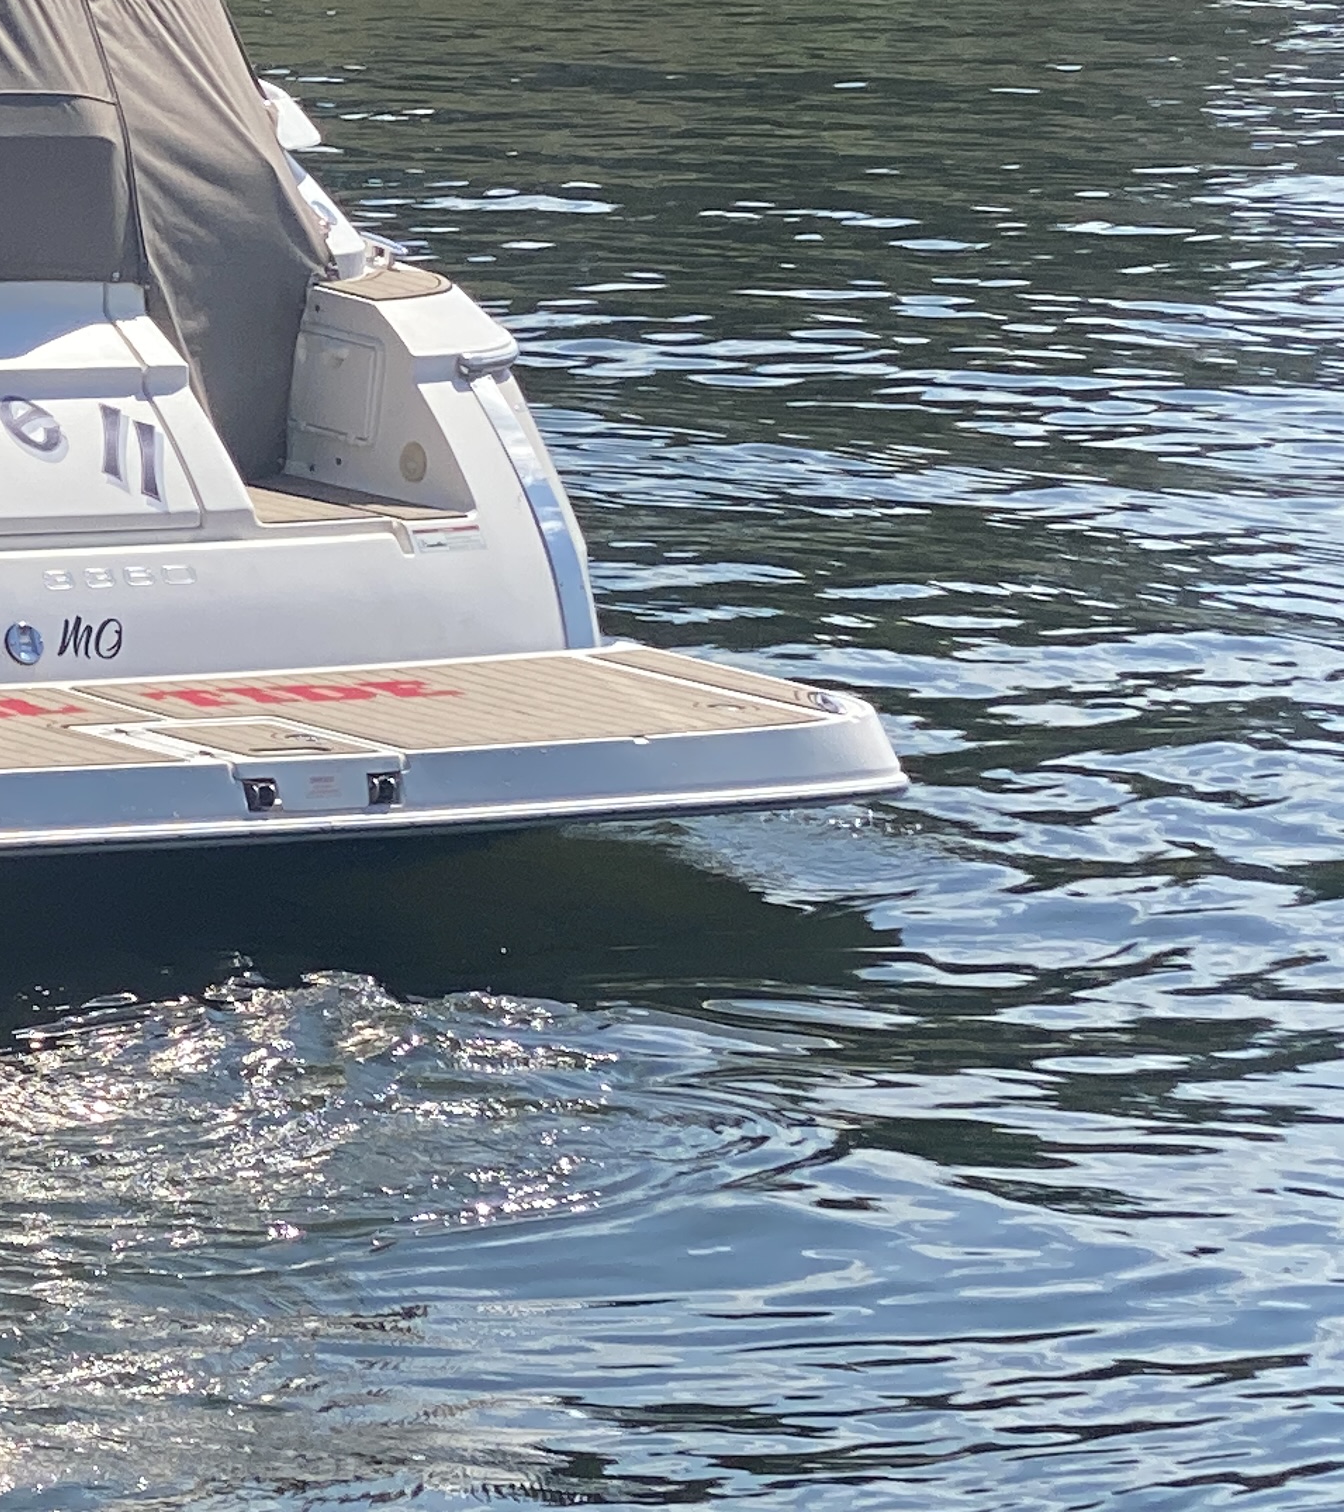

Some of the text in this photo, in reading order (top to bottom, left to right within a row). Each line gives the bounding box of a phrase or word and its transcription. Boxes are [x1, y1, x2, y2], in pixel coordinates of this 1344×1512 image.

[42, 564, 198, 591] 3360
[56, 614, 124, 660] MO
[139, 679, 466, 707] TIDE
